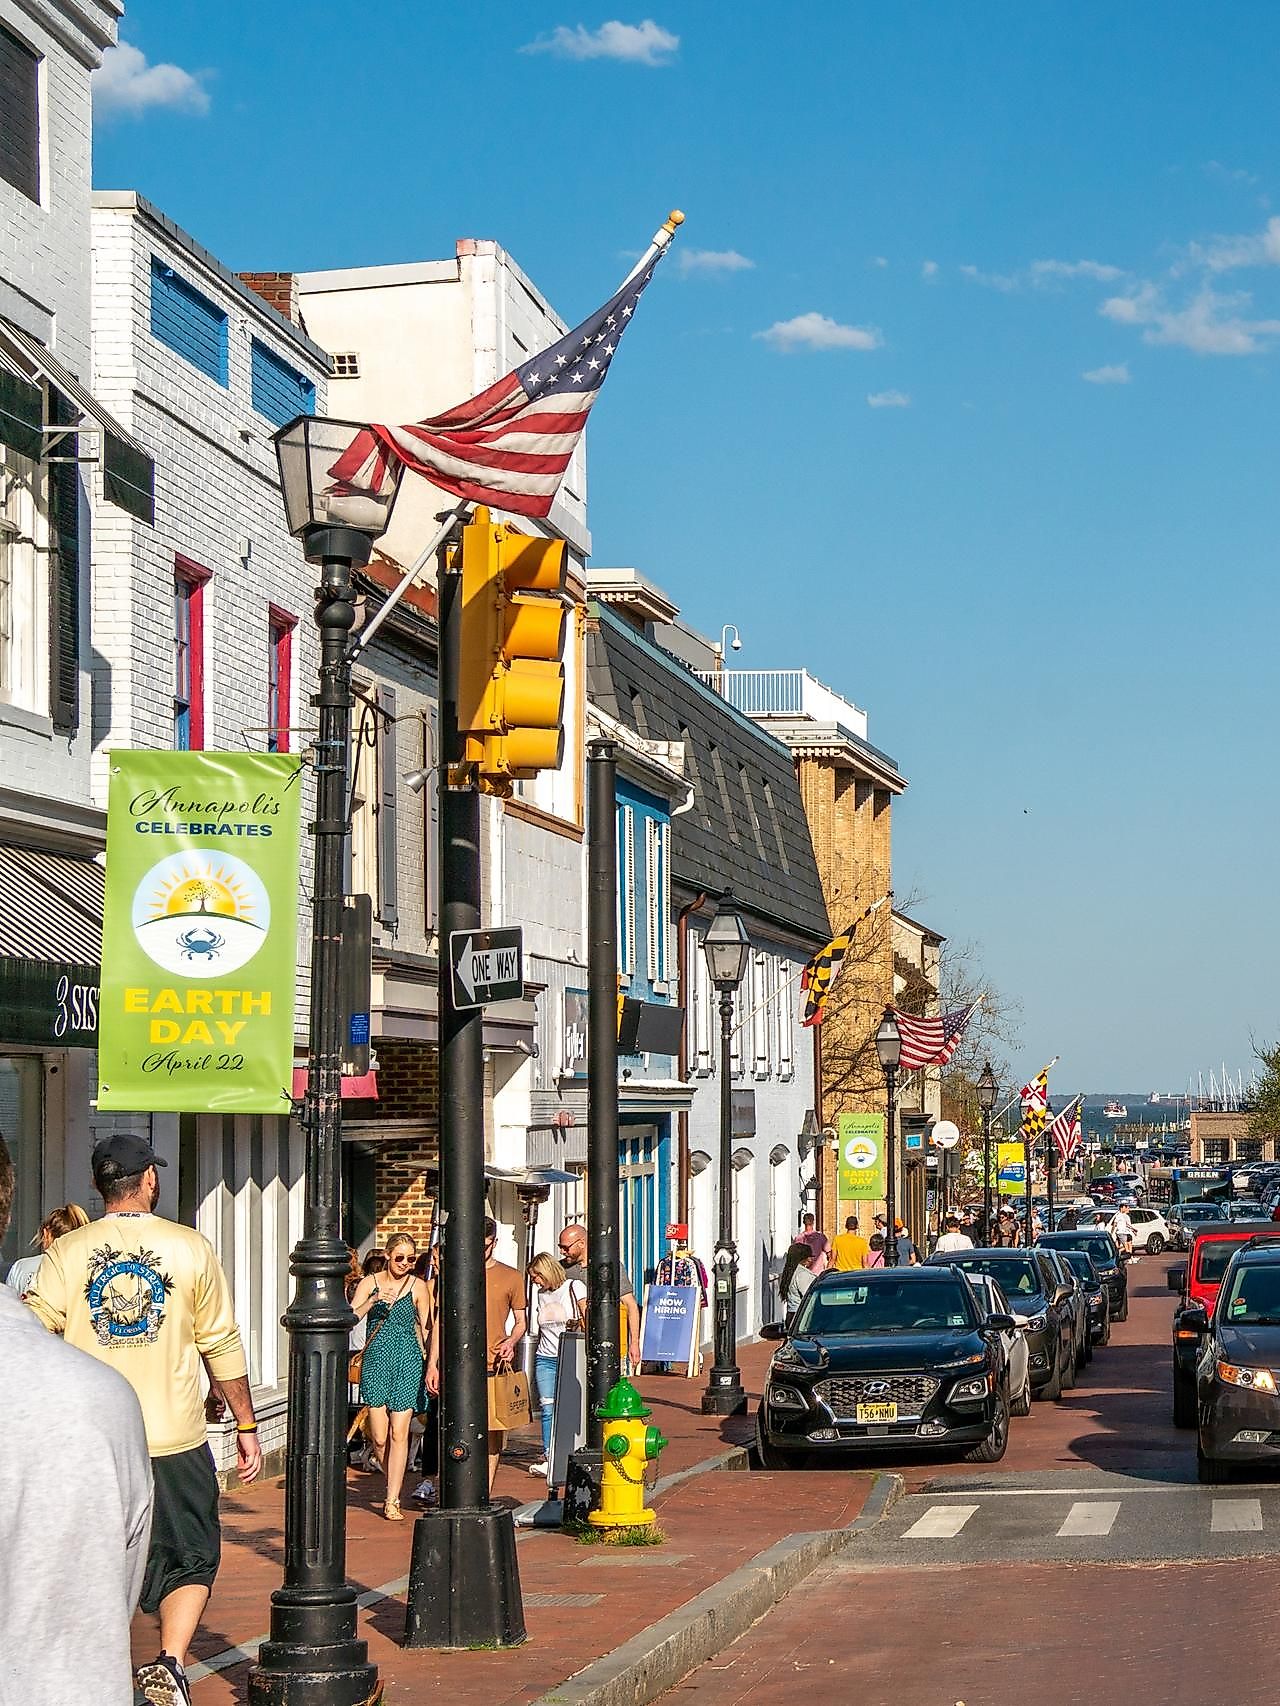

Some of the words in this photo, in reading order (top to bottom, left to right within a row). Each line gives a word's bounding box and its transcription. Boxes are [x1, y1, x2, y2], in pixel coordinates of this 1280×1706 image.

[129, 786, 280, 822] Annapolis
[135, 821, 272, 836] CELEBRATES
[472, 954, 490, 982] ONE
[497, 951, 516, 979] WAY
[55, 975, 68, 1037] 3
[124, 987, 272, 1016] EARTH
[150, 1019, 247, 1046] DAY
[142, 1050, 213, 1075] April
[216, 1054, 244, 1070] 22
[844, 1169, 879, 1177] EARTH
[849, 1177, 872, 1185] DAY
[1187, 1171, 1219, 1179] GREEN
[90, 1265, 120, 1306] ALLERGIC
[126, 1263, 136, 1272] TO
[138, 1266, 163, 1303] STRESS
[654, 1305, 687, 1315] HIRING
[660, 1298, 683, 1306] NOW
